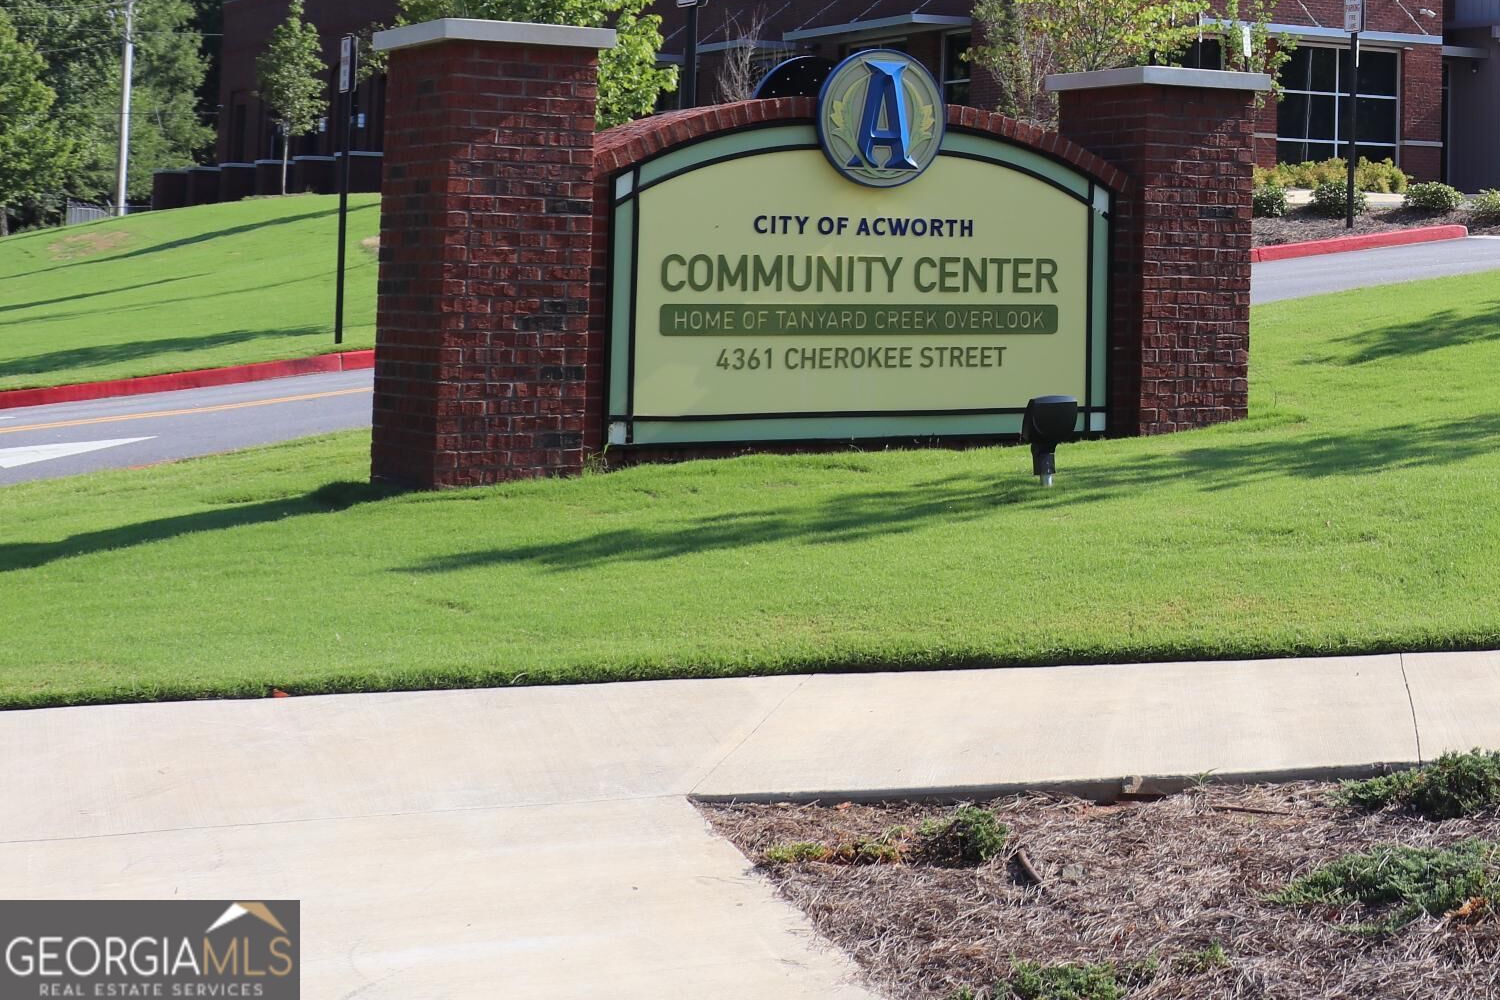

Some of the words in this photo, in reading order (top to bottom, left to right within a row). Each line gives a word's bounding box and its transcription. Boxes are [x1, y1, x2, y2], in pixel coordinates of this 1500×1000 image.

[844, 57, 919, 171] A
[753, 215, 810, 235] CITY
[817, 216, 849, 236] OF
[856, 217, 974, 238] ACWORTH
[660, 253, 904, 293] COMMUNITY
[913, 256, 1059, 294] CENTER
[674, 311, 736, 330] HOME
[742, 311, 769, 330] OF
[775, 311, 867, 330] TANYARD
[874, 311, 938, 329] CREEK
[944, 311, 1046, 329] OVERLOOK
[716, 347, 773, 370] 4361
[784, 346, 913, 370] CHEROKEE
[919, 345, 1008, 369] STREET
